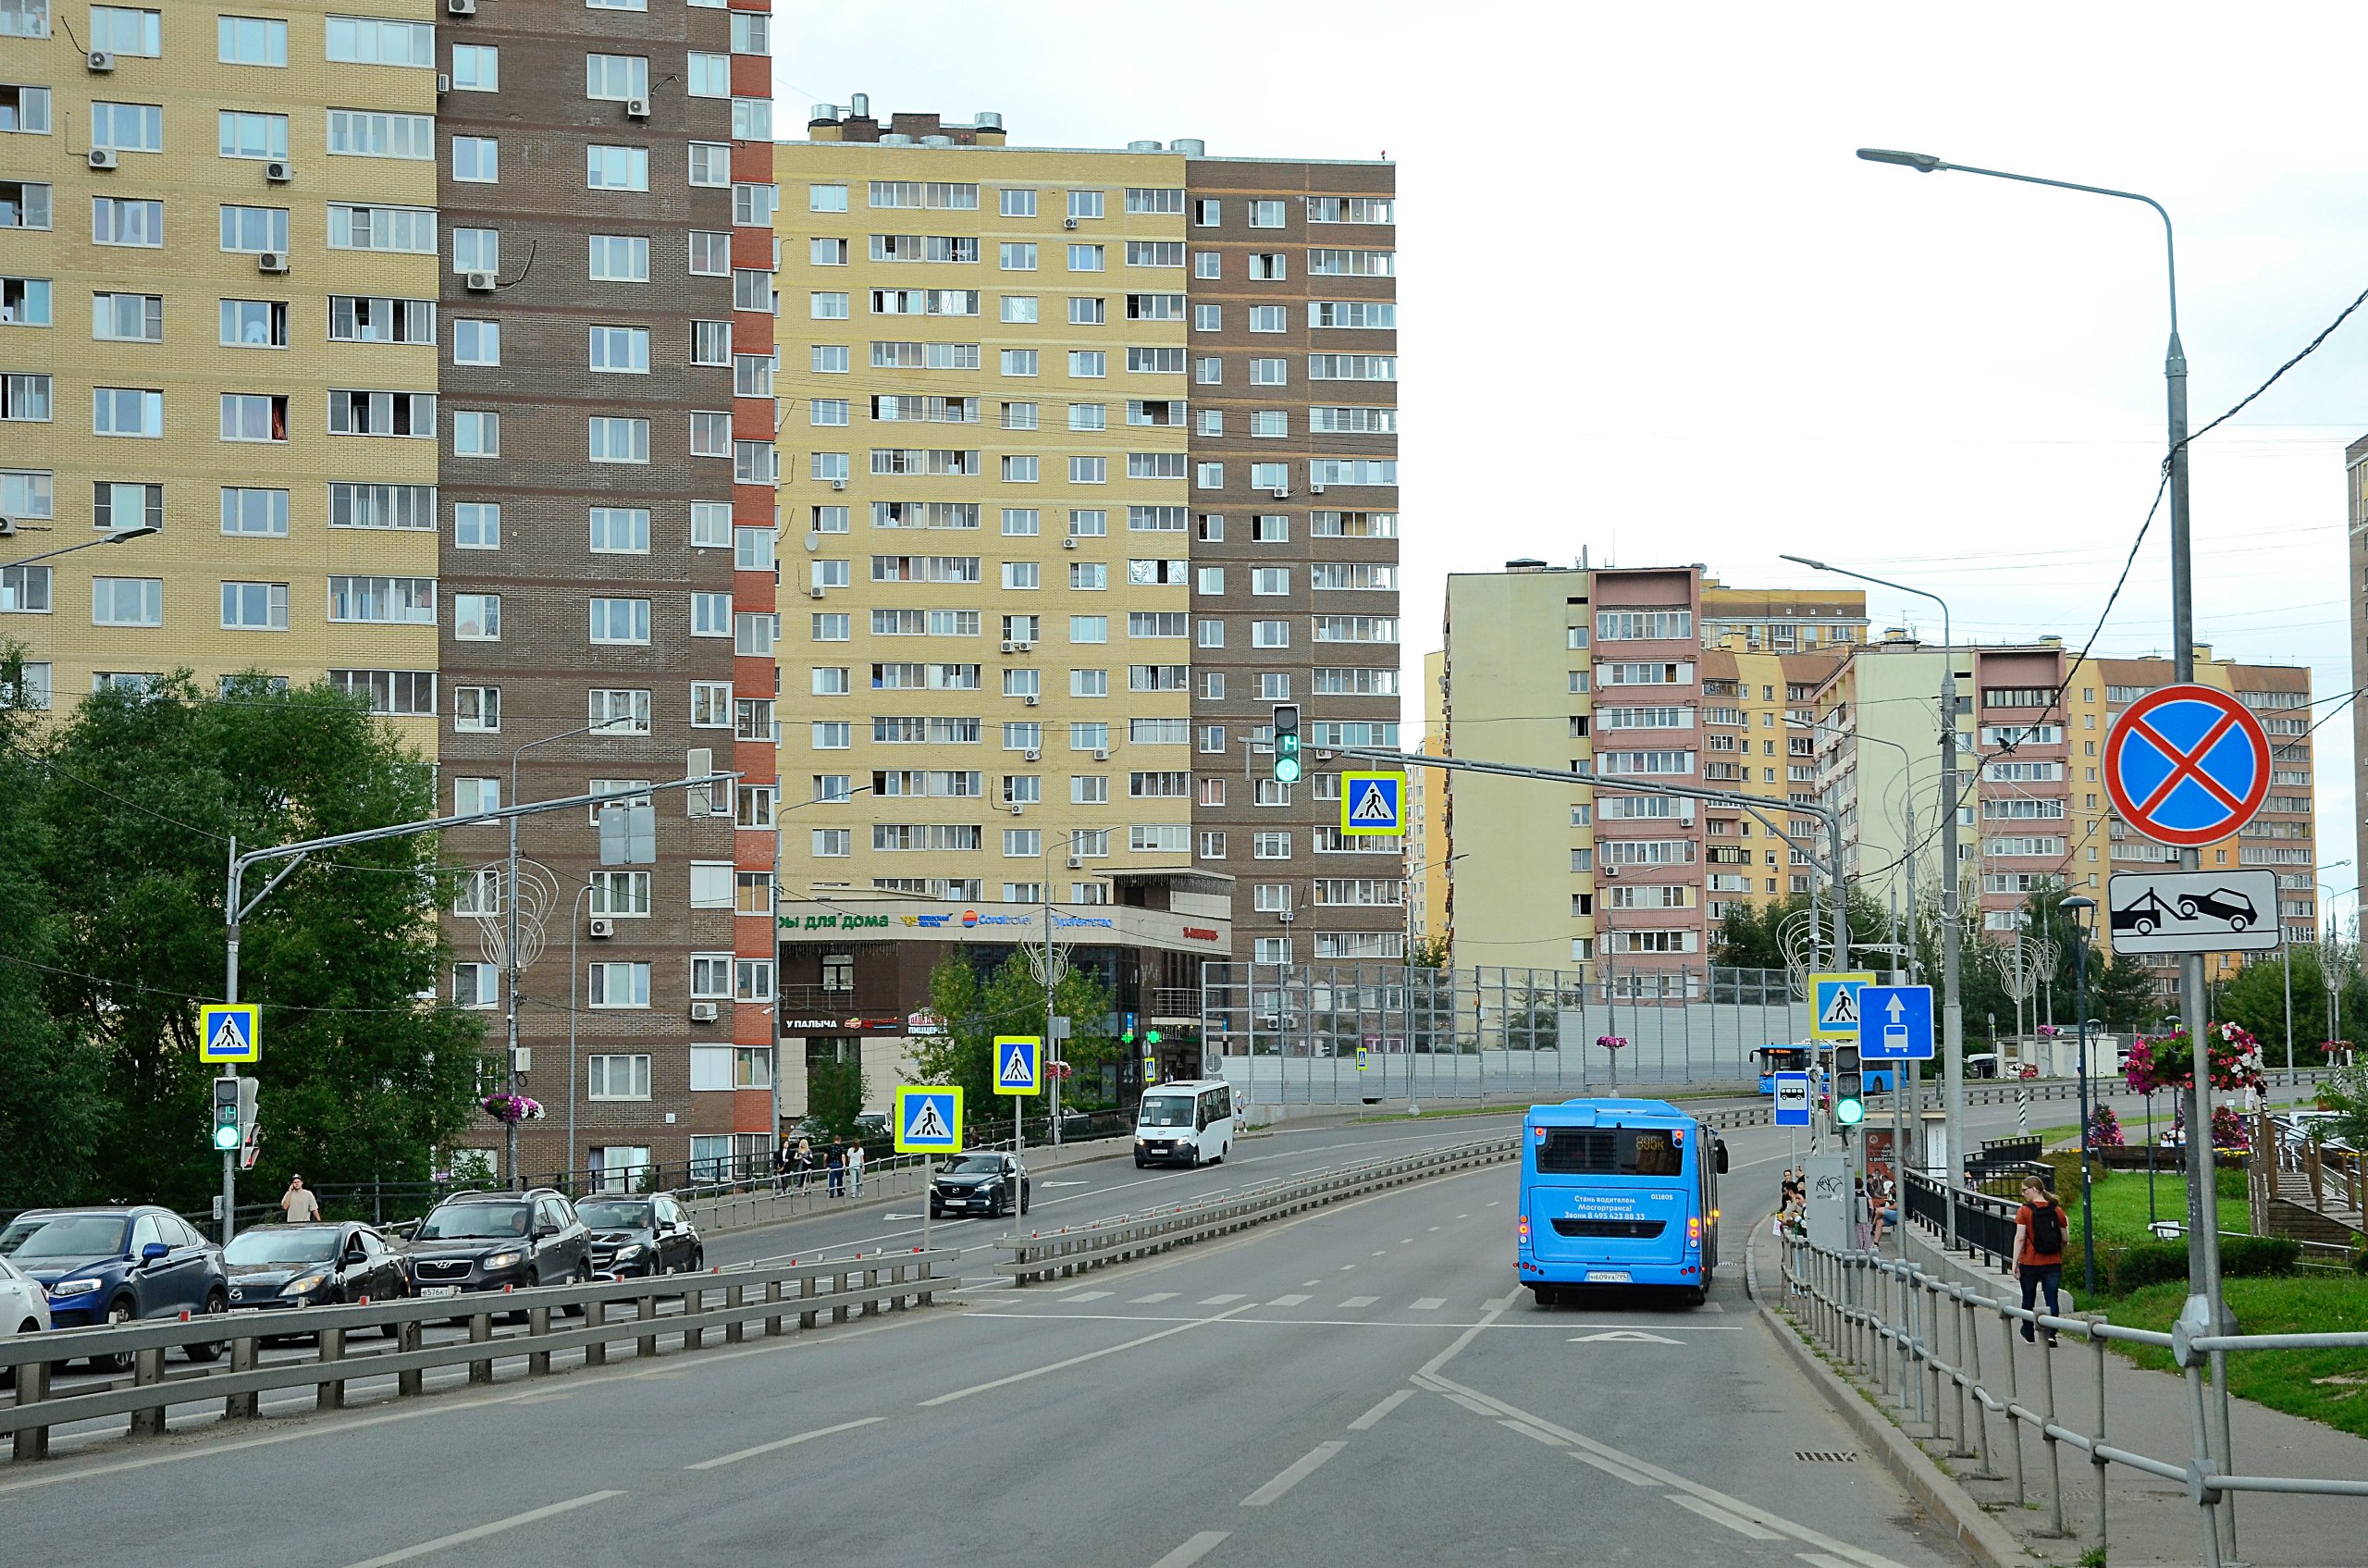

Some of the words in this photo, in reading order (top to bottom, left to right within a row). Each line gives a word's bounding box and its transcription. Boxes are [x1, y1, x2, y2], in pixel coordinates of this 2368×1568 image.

[805, 916, 836, 931] для
[841, 915, 889, 930] дома
[786, 1020, 794, 1029] У
[795, 1019, 837, 1029] ПАЛЫЧА
[1597, 1196, 1635, 1204] водителем
[1578, 1204, 1632, 1212] Мосгортранса!
[1564, 1211, 1586, 1219] Звони
